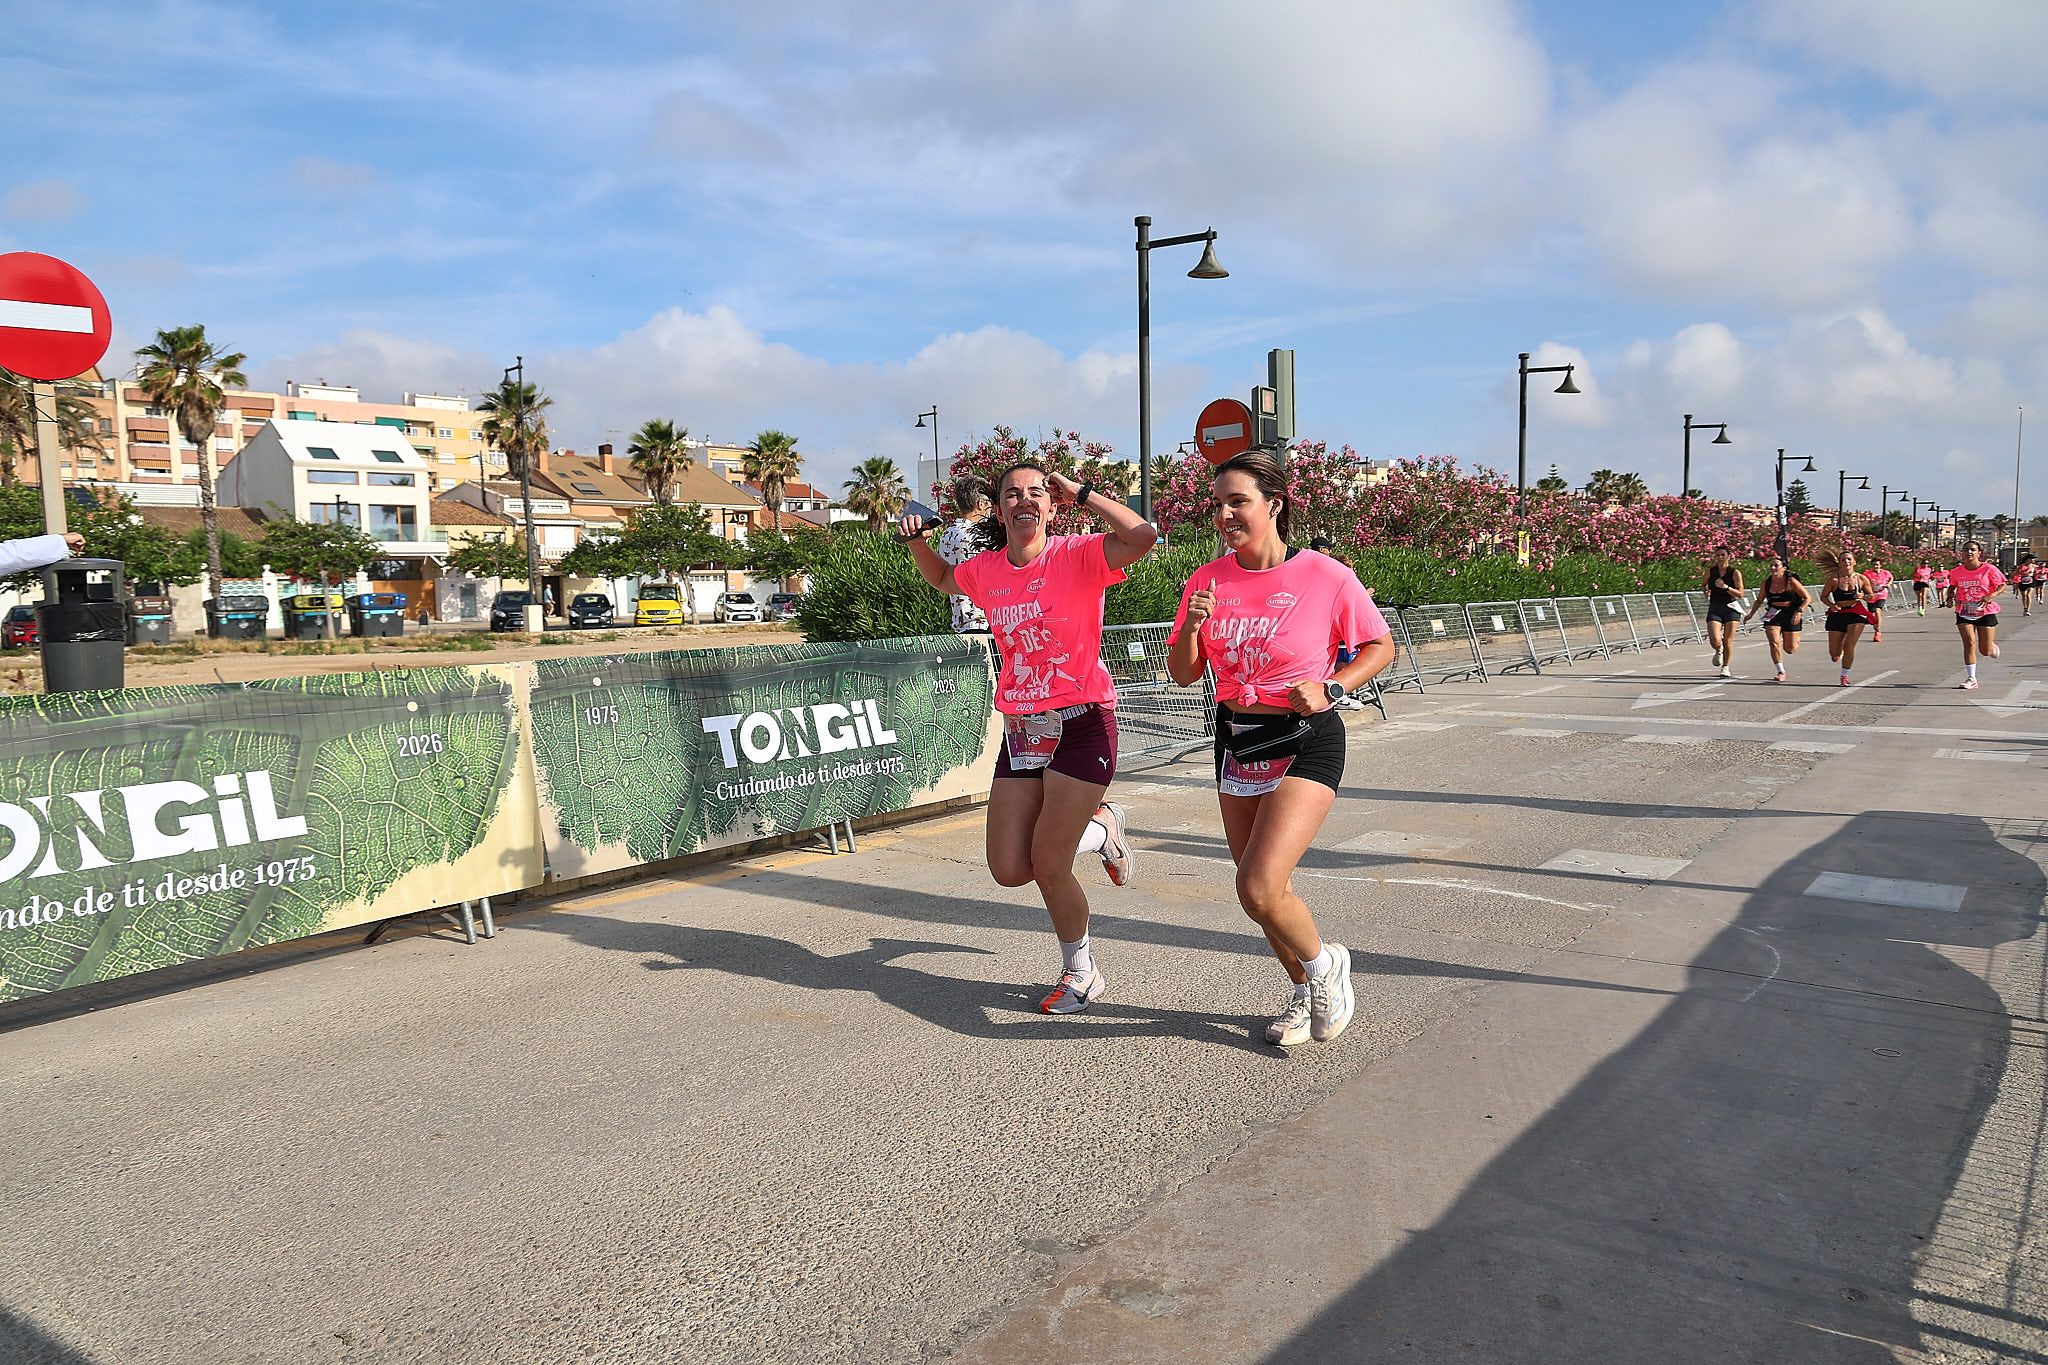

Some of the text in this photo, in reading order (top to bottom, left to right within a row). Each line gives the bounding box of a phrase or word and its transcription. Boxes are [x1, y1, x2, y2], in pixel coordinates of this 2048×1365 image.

[1215, 597, 1241, 607] YSHO
[933, 679, 955, 694] 2026
[584, 705, 619, 726] 1975
[397, 733, 443, 757] 2026
[716, 756, 904, 800] Cuidando de ti desde 1975
[73, 885, 115, 917] de
[122, 878, 149, 908] ti
[155, 864, 246, 902] desde
[253, 854, 316, 887] 1975
